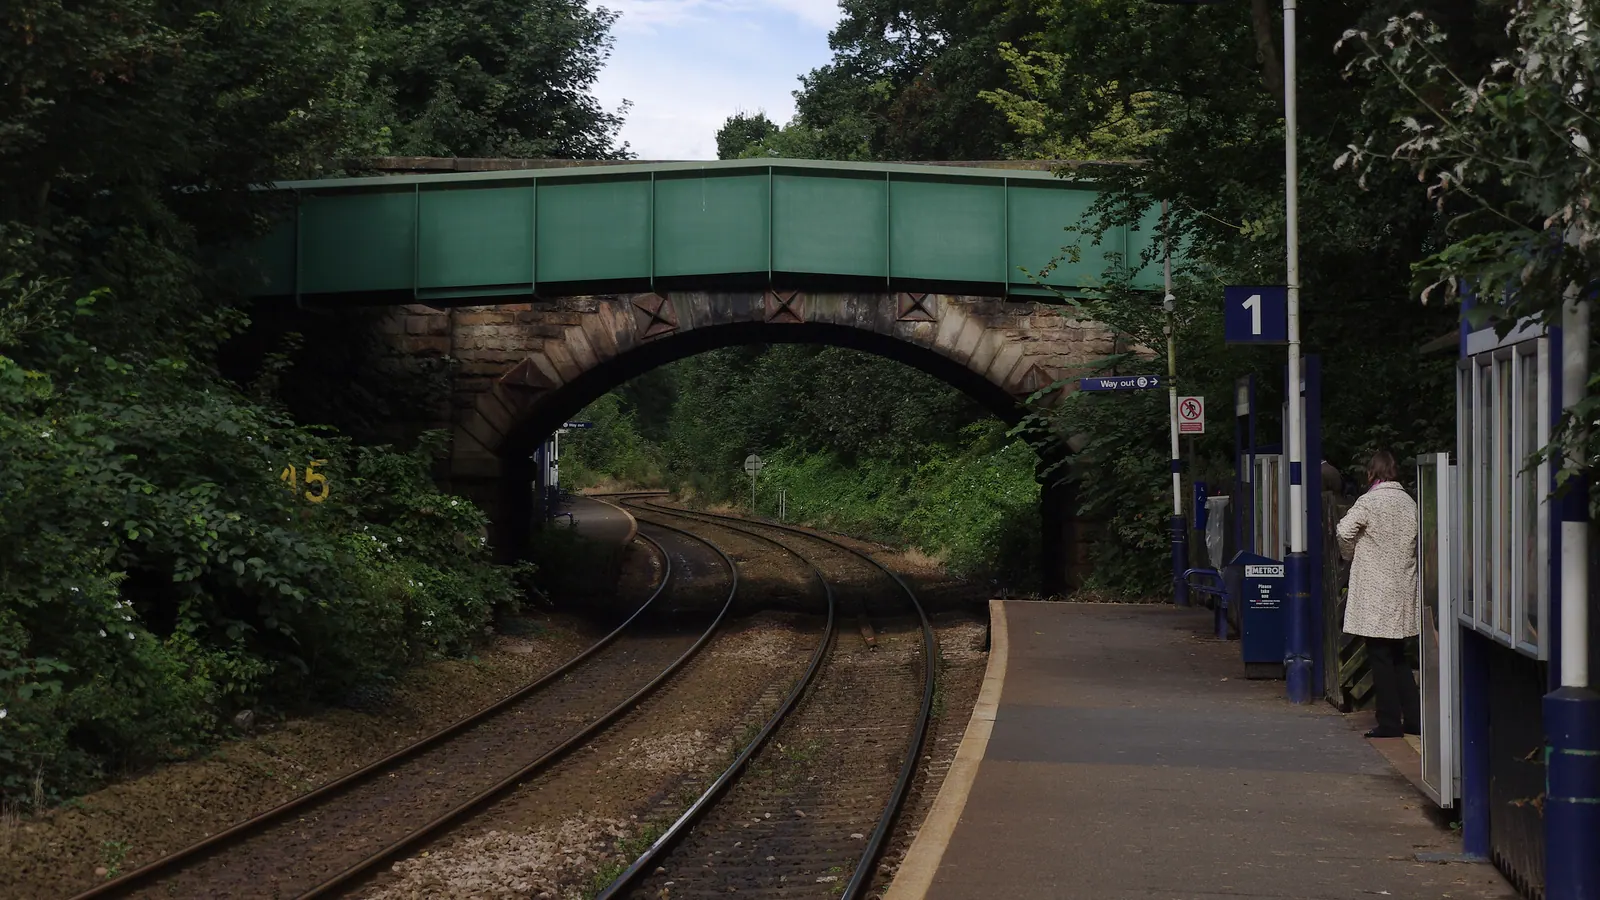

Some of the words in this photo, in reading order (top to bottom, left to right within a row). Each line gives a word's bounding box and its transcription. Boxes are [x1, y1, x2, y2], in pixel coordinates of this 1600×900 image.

[1241, 294, 1262, 335] 1
[1100, 380, 1118, 389] Way
[1120, 379, 1135, 387] out
[1252, 567, 1279, 575] METRO
